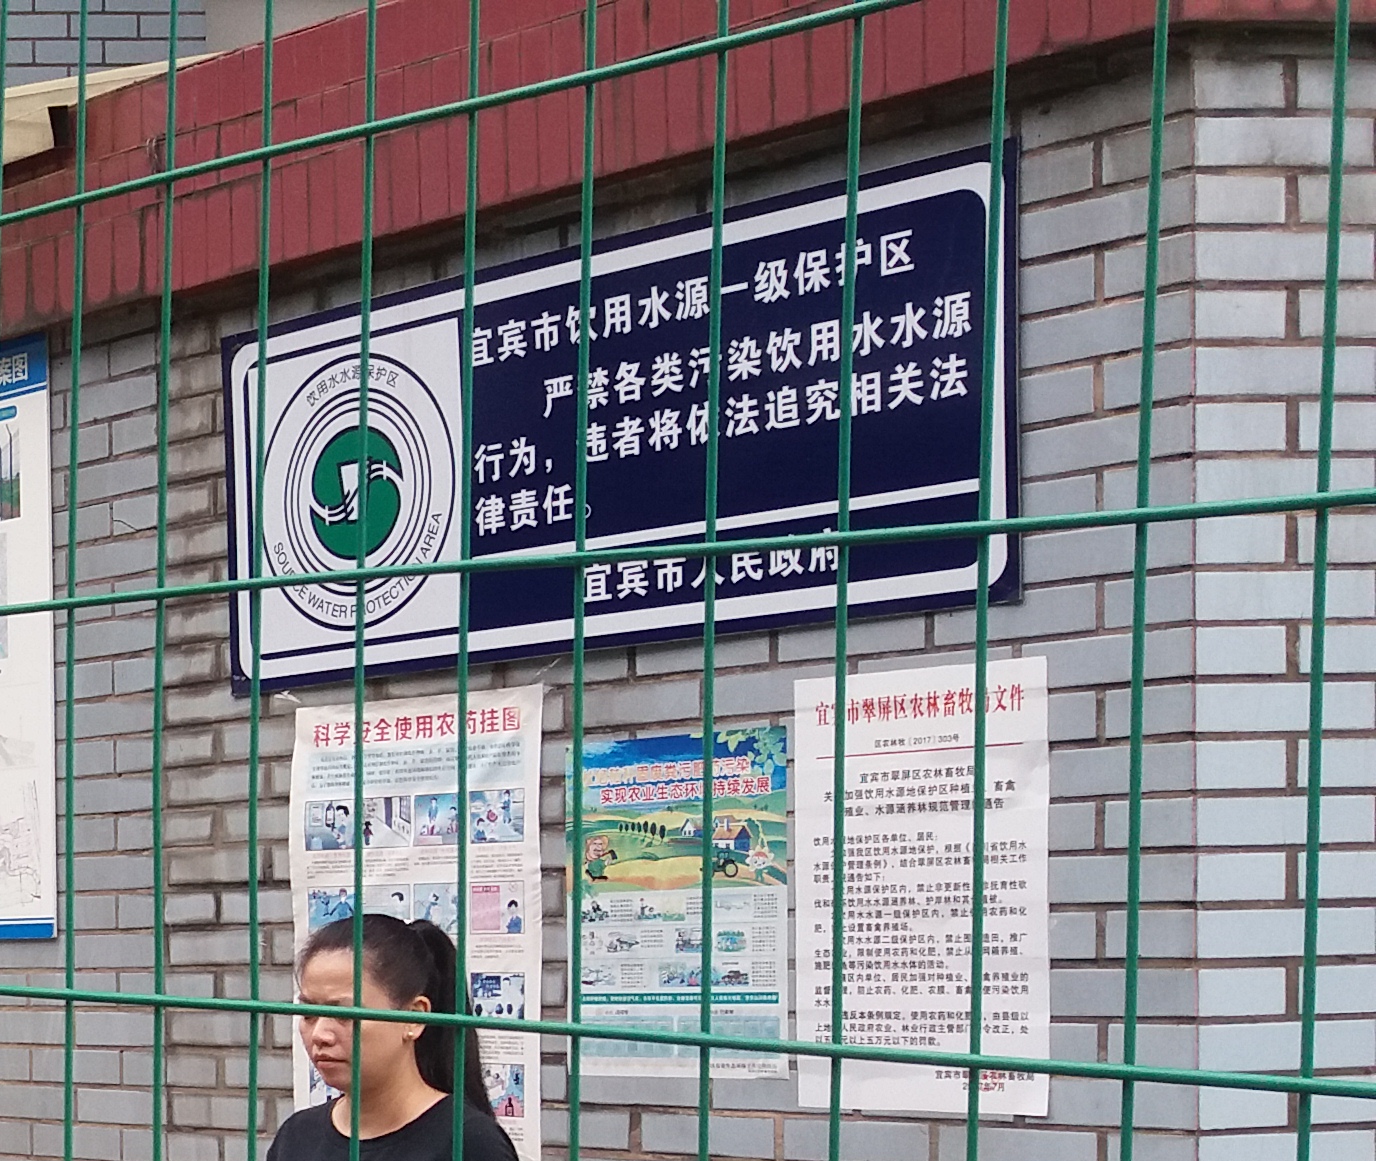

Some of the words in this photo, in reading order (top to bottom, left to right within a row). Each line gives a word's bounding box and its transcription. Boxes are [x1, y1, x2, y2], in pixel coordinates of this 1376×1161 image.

[471, 229, 915, 367] 宜宾市饮用水源一级保护区
[543, 291, 972, 418] 严禁各类污染饮用水水源
[420, 512, 443, 559] AREA
[815, 683, 1025, 727] 宜市翠屏区农林畜牧文件
